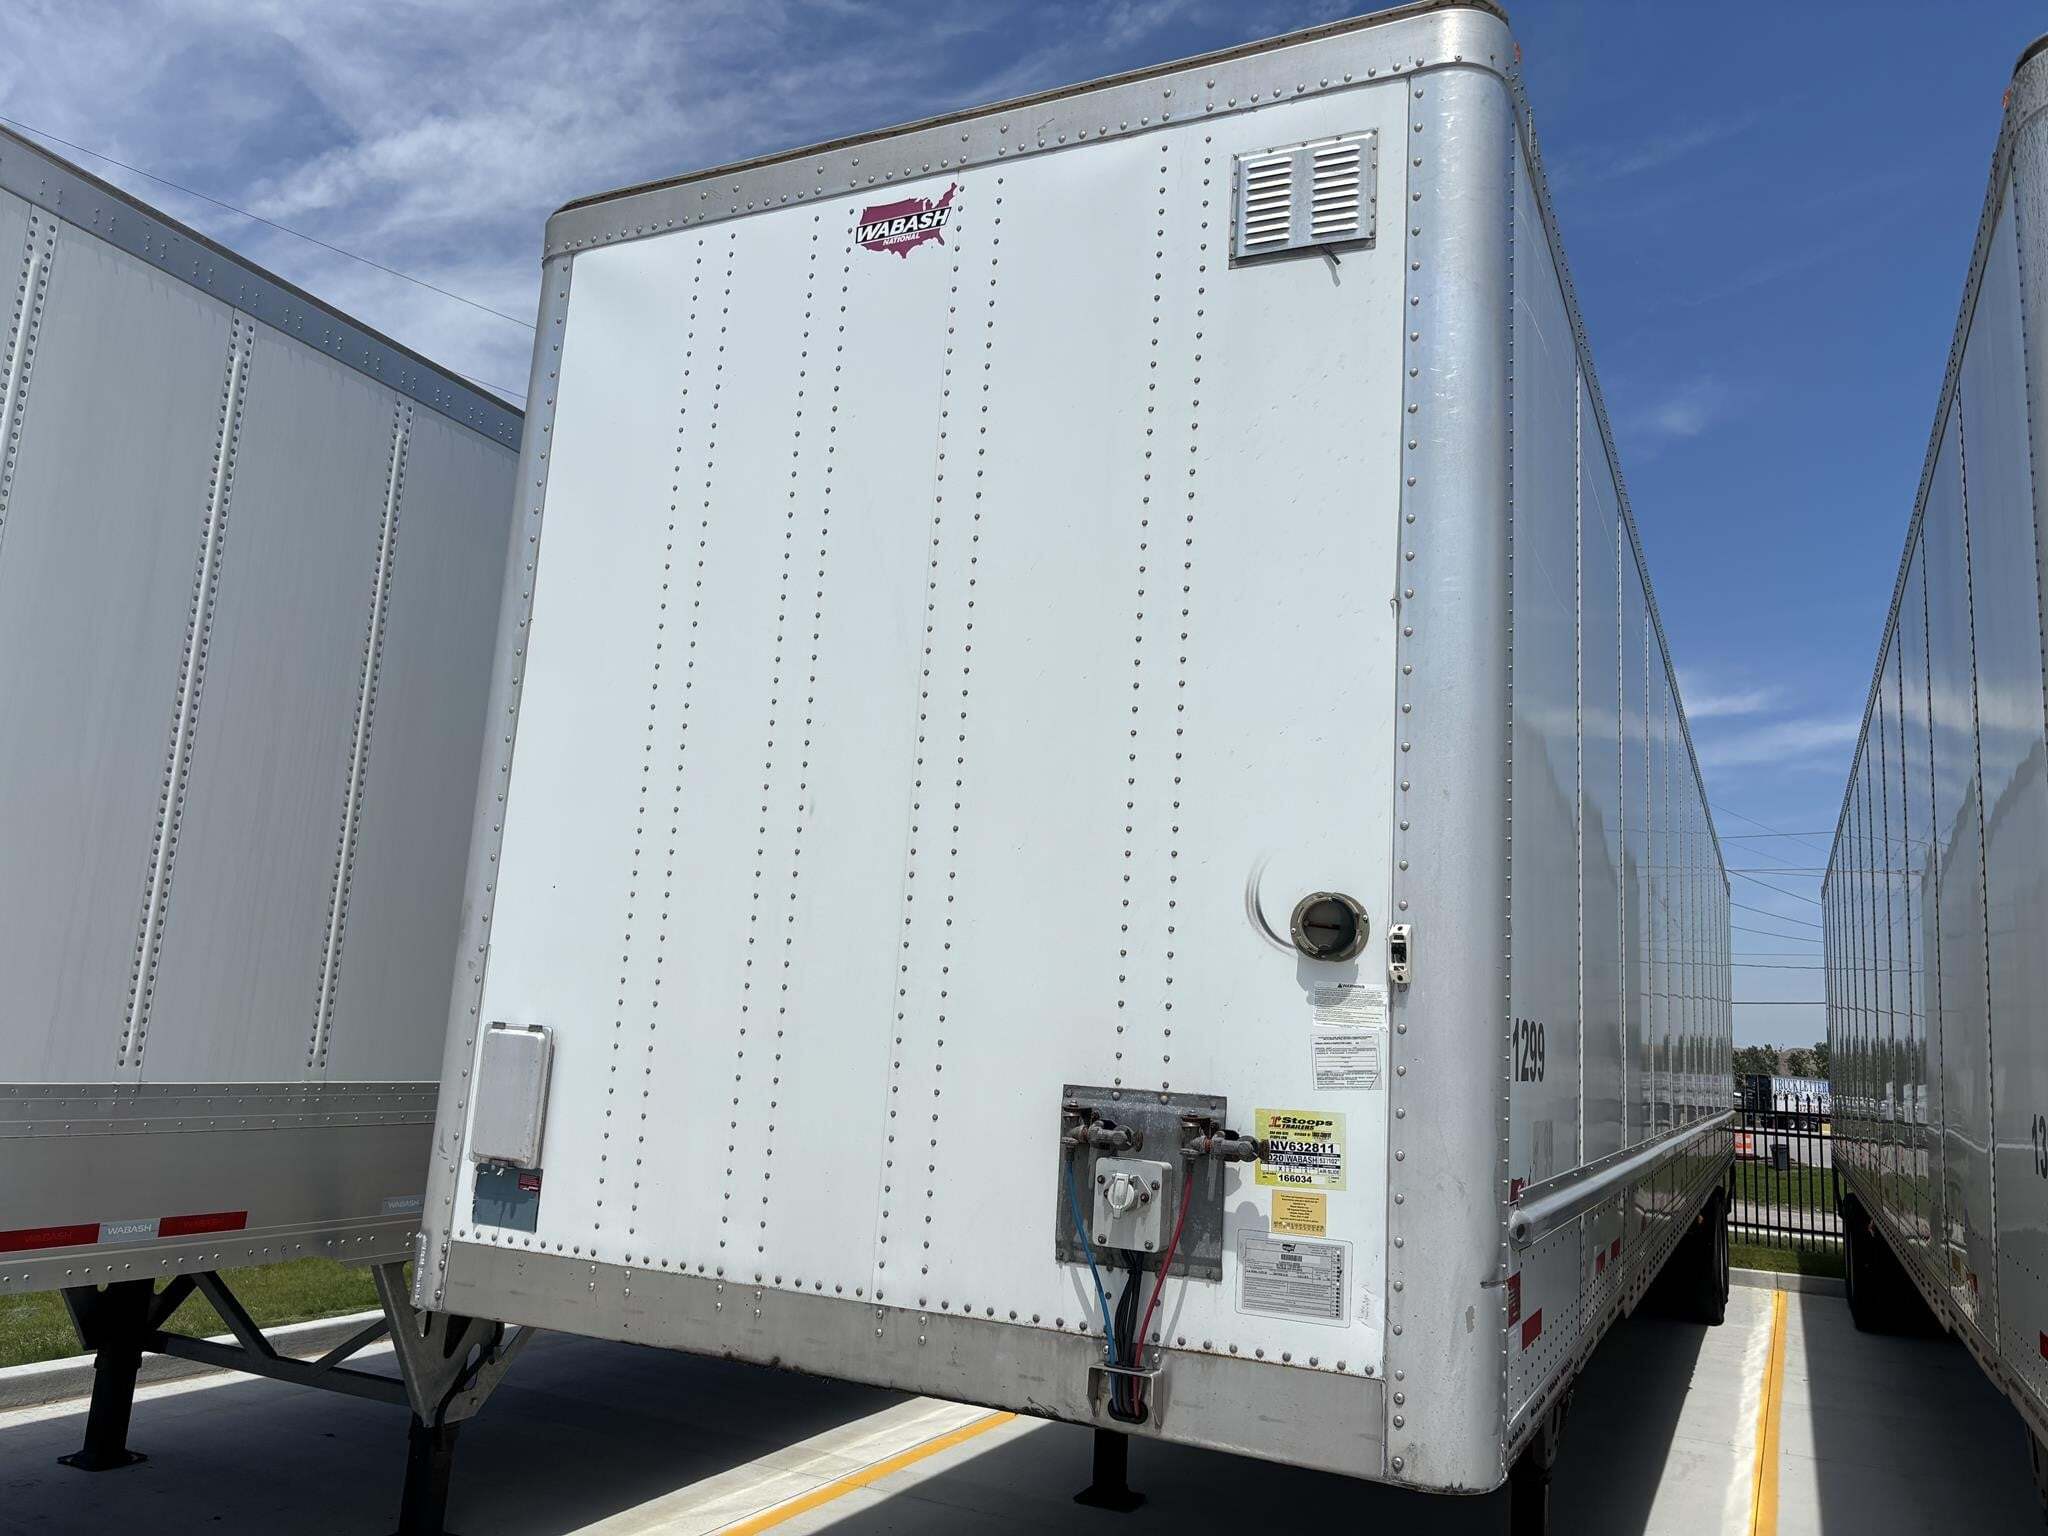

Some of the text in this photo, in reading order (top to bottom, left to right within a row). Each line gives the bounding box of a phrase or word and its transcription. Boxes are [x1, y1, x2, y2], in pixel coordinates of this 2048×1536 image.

[857, 208, 950, 243] WABASH
[883, 233, 920, 245] NATIONAL
[1512, 1018, 1545, 1082] 1299
[1281, 1117, 1333, 1127] Stoops
[1270, 1140, 1334, 1154] NV632811
[1269, 1153, 1284, 1161] 020
[1286, 1154, 1318, 1165] WABASH
[1278, 1174, 1312, 1184] 166034
[107, 1223, 153, 1235] WABASH
